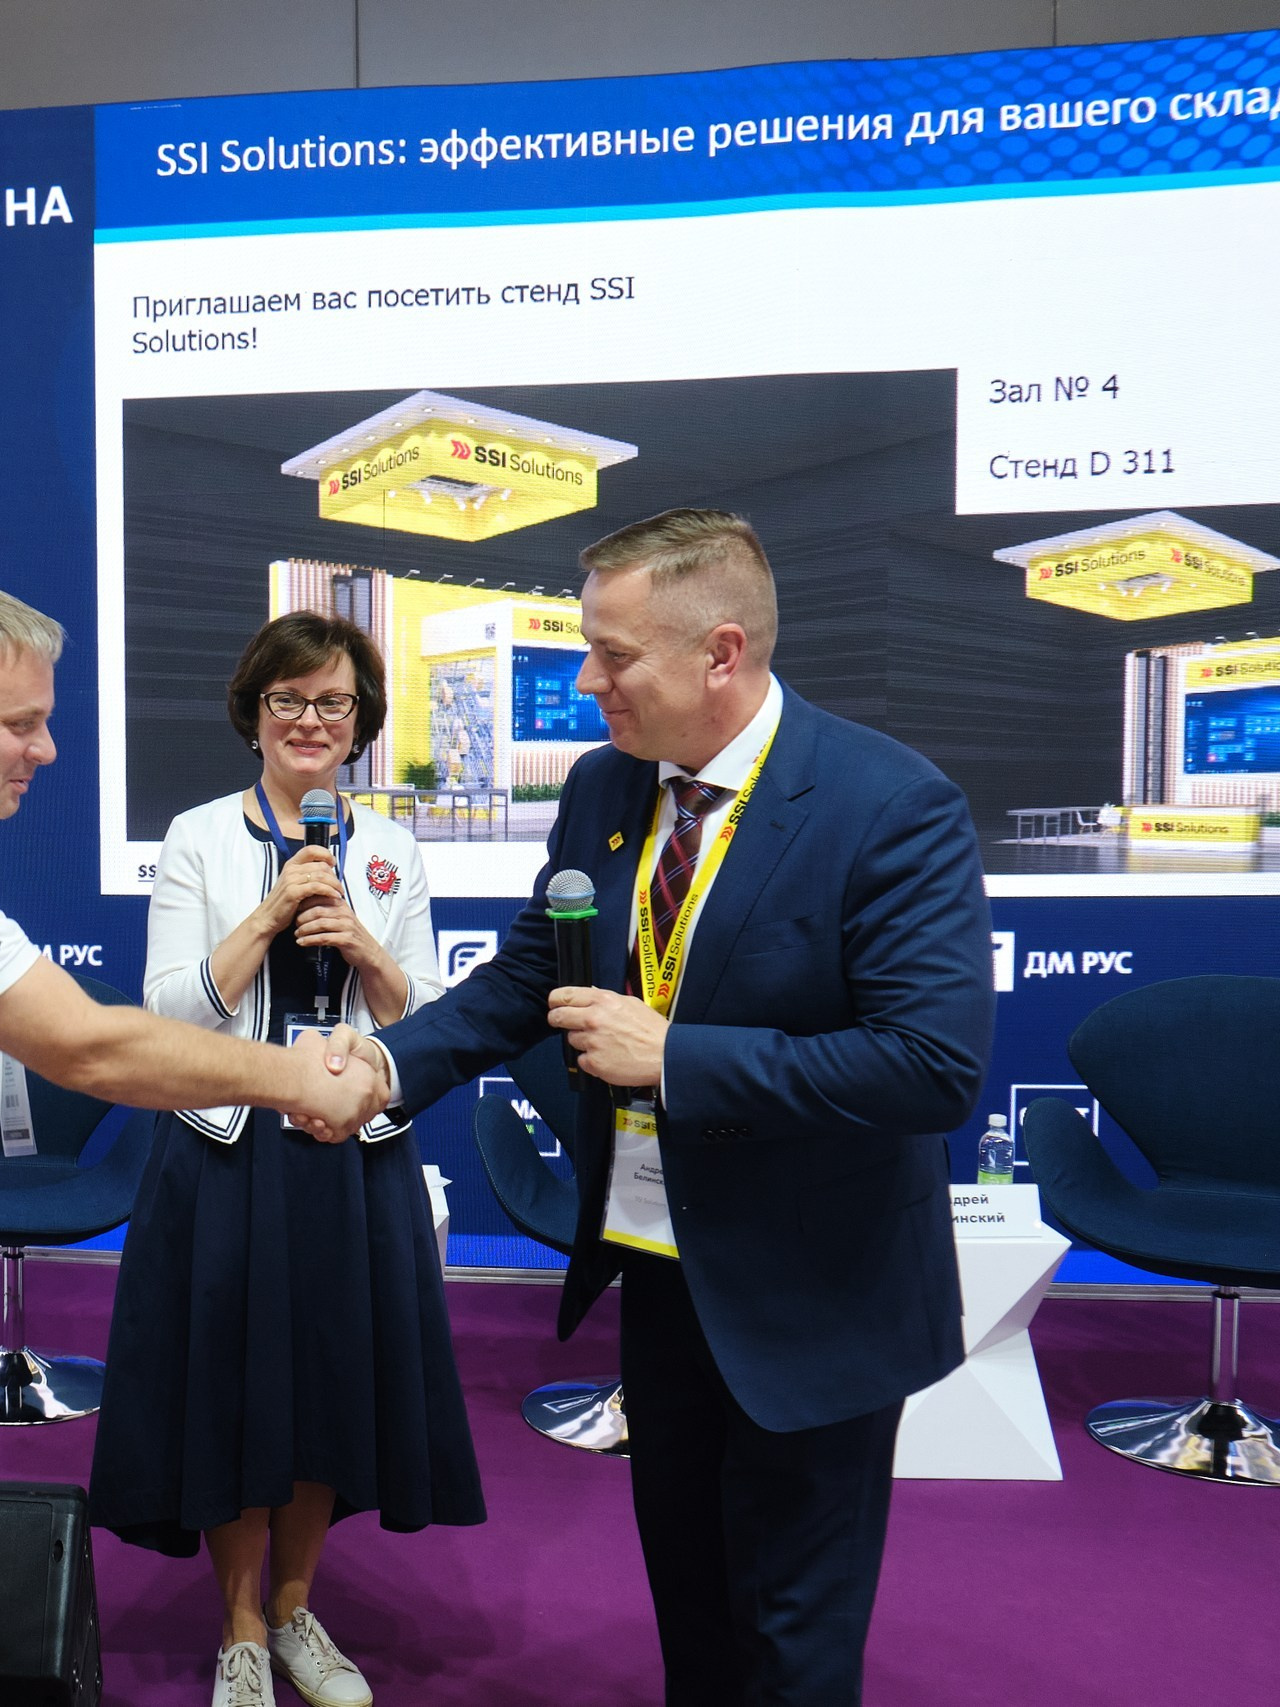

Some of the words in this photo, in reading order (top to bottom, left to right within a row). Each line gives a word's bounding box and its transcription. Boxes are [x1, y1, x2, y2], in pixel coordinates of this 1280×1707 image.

[156, 142, 208, 176] SSI
[220, 135, 407, 173] Solutions:
[419, 125, 696, 170] эффективные
[708, 114, 893, 157] решения
[904, 107, 985, 146] для
[999, 96, 1157, 132] вашего
[132, 291, 301, 323] Приглашаем
[312, 290, 358, 311] вас
[367, 286, 491, 308] посетить
[500, 282, 580, 306] стенд
[589, 276, 636, 301] SSI
[131, 327, 259, 354] Solutions!
[989, 379, 1042, 404] Зал
[1055, 376, 1090, 401] №
[1101, 374, 1120, 399] 4
[341, 467, 362, 491] SSI
[362, 444, 421, 481] Solutions
[474, 446, 507, 468] SSI
[508, 454, 584, 487] Solutions
[989, 454, 1078, 480] Стенд
[1090, 451, 1111, 476] D
[1122, 448, 1176, 475] 311
[1055, 561, 1079, 578] SSI
[1080, 549, 1146, 572] Solutions
[542, 619, 564, 633] SSI
[1154, 821, 1175, 833] SSI
[640, 907, 650, 932] SSI
[662, 956, 677, 982] SSI
[671, 893, 699, 955] Solutions
[59, 944, 103, 966] РУС
[641, 934, 656, 998] Solutions
[1023, 951, 1075, 978] ДМ
[1081, 951, 1133, 974] РУС
[640, 1163, 663, 1175] Андре
[953, 1194, 989, 1207] дрей
